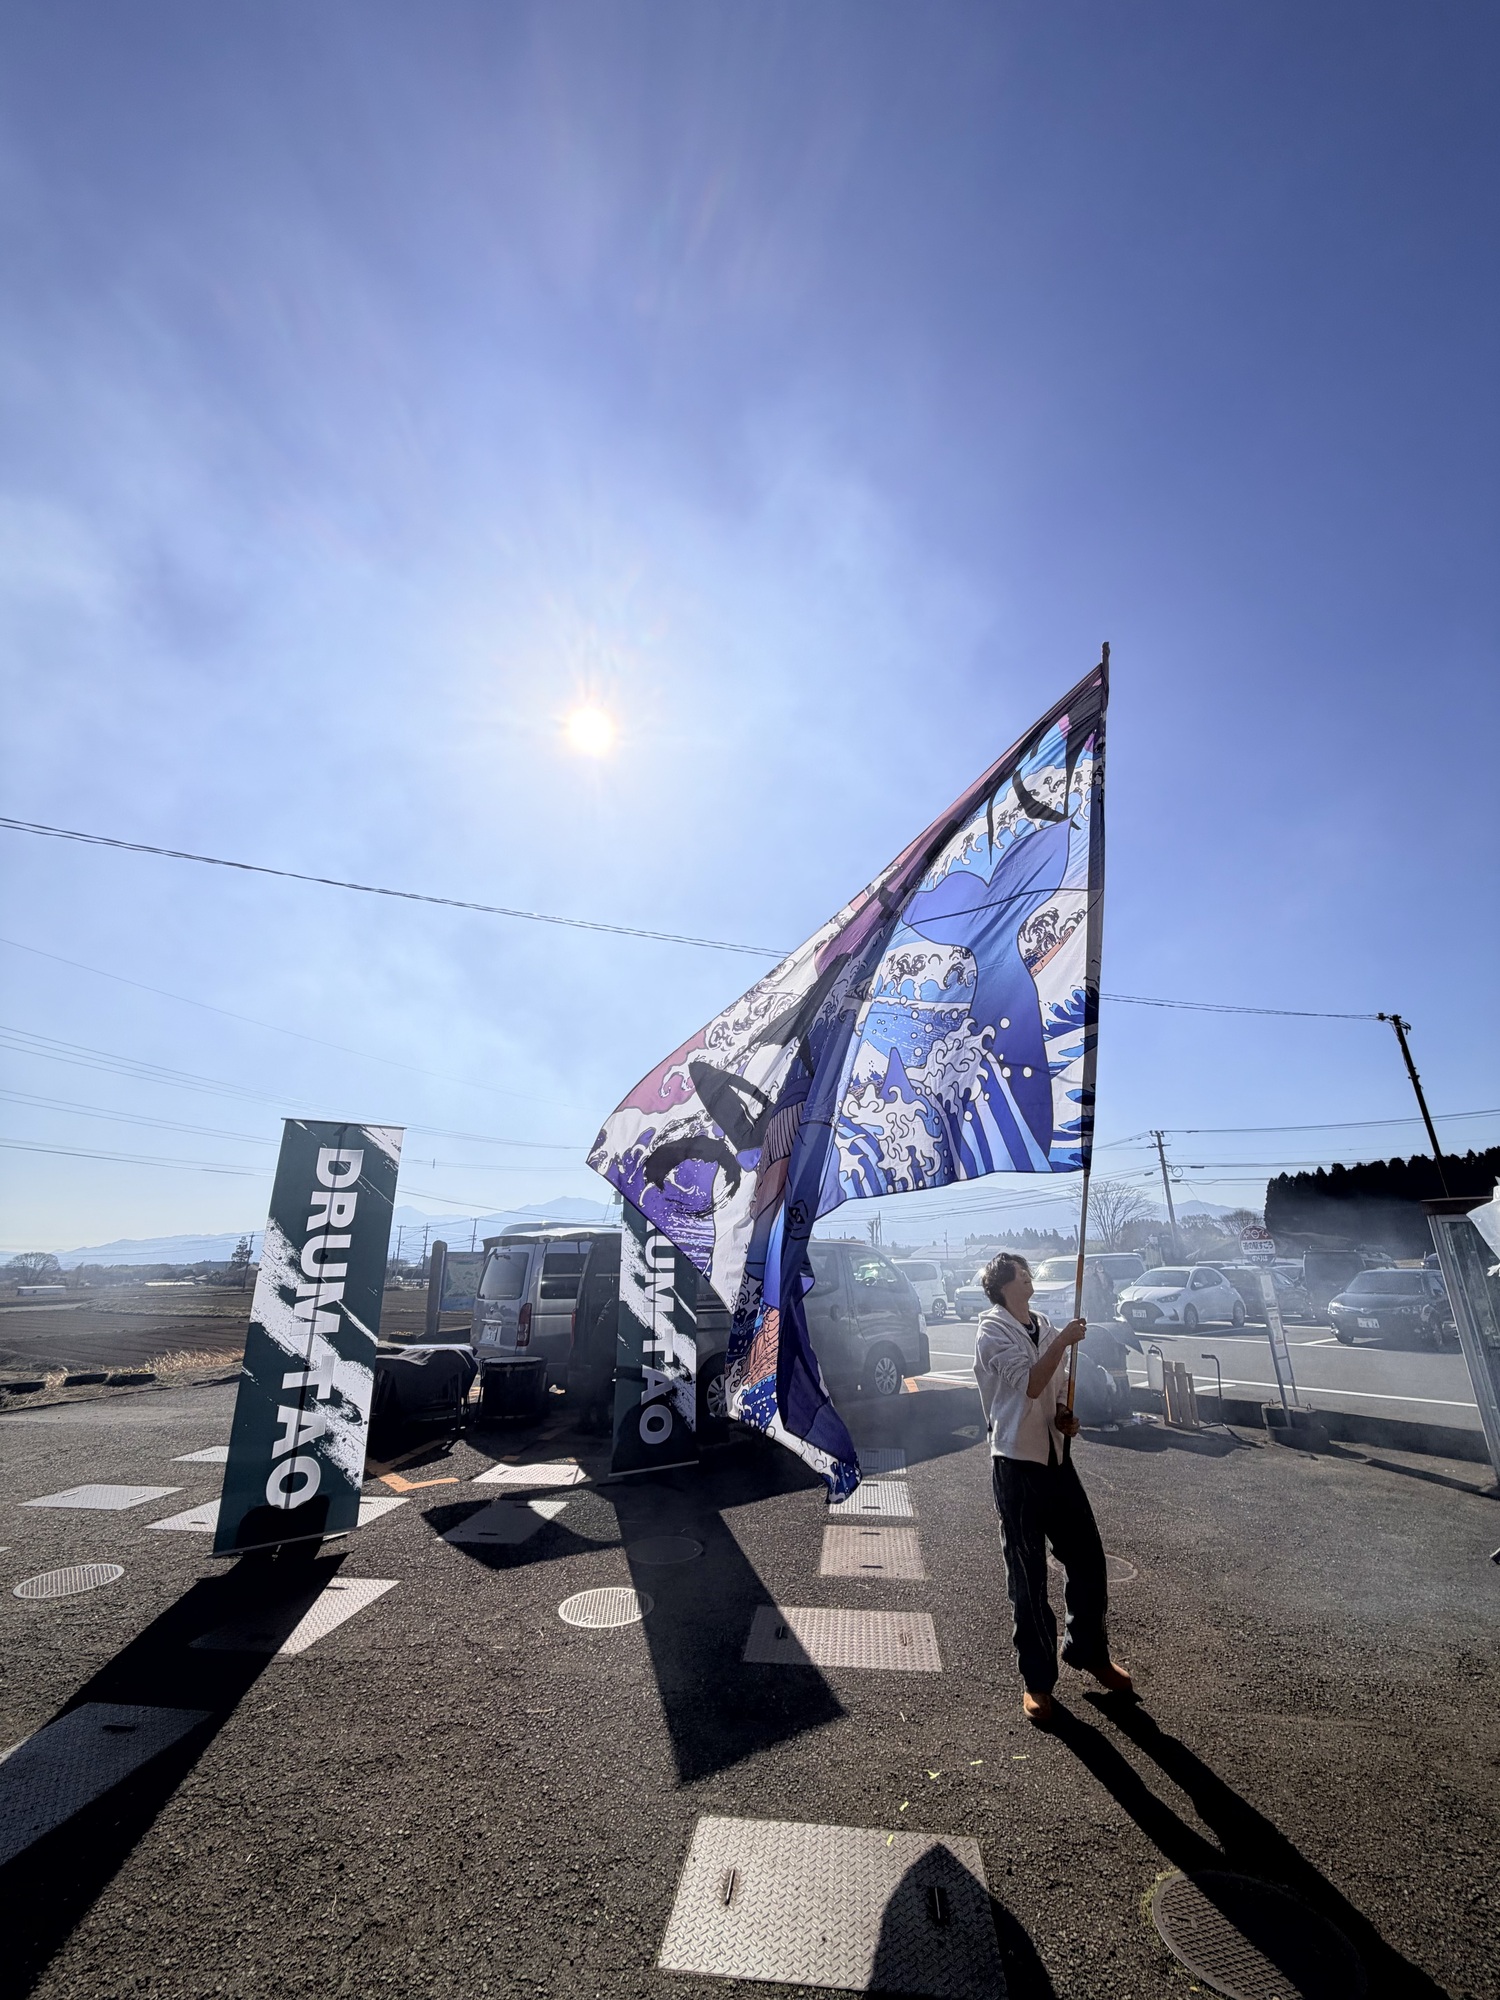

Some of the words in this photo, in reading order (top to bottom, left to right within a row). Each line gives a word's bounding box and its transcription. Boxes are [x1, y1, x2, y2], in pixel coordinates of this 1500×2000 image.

[290, 1147, 365, 1336] DRUM
[266, 1354, 336, 1510] TAO
[639, 1327, 674, 1444] TAO
